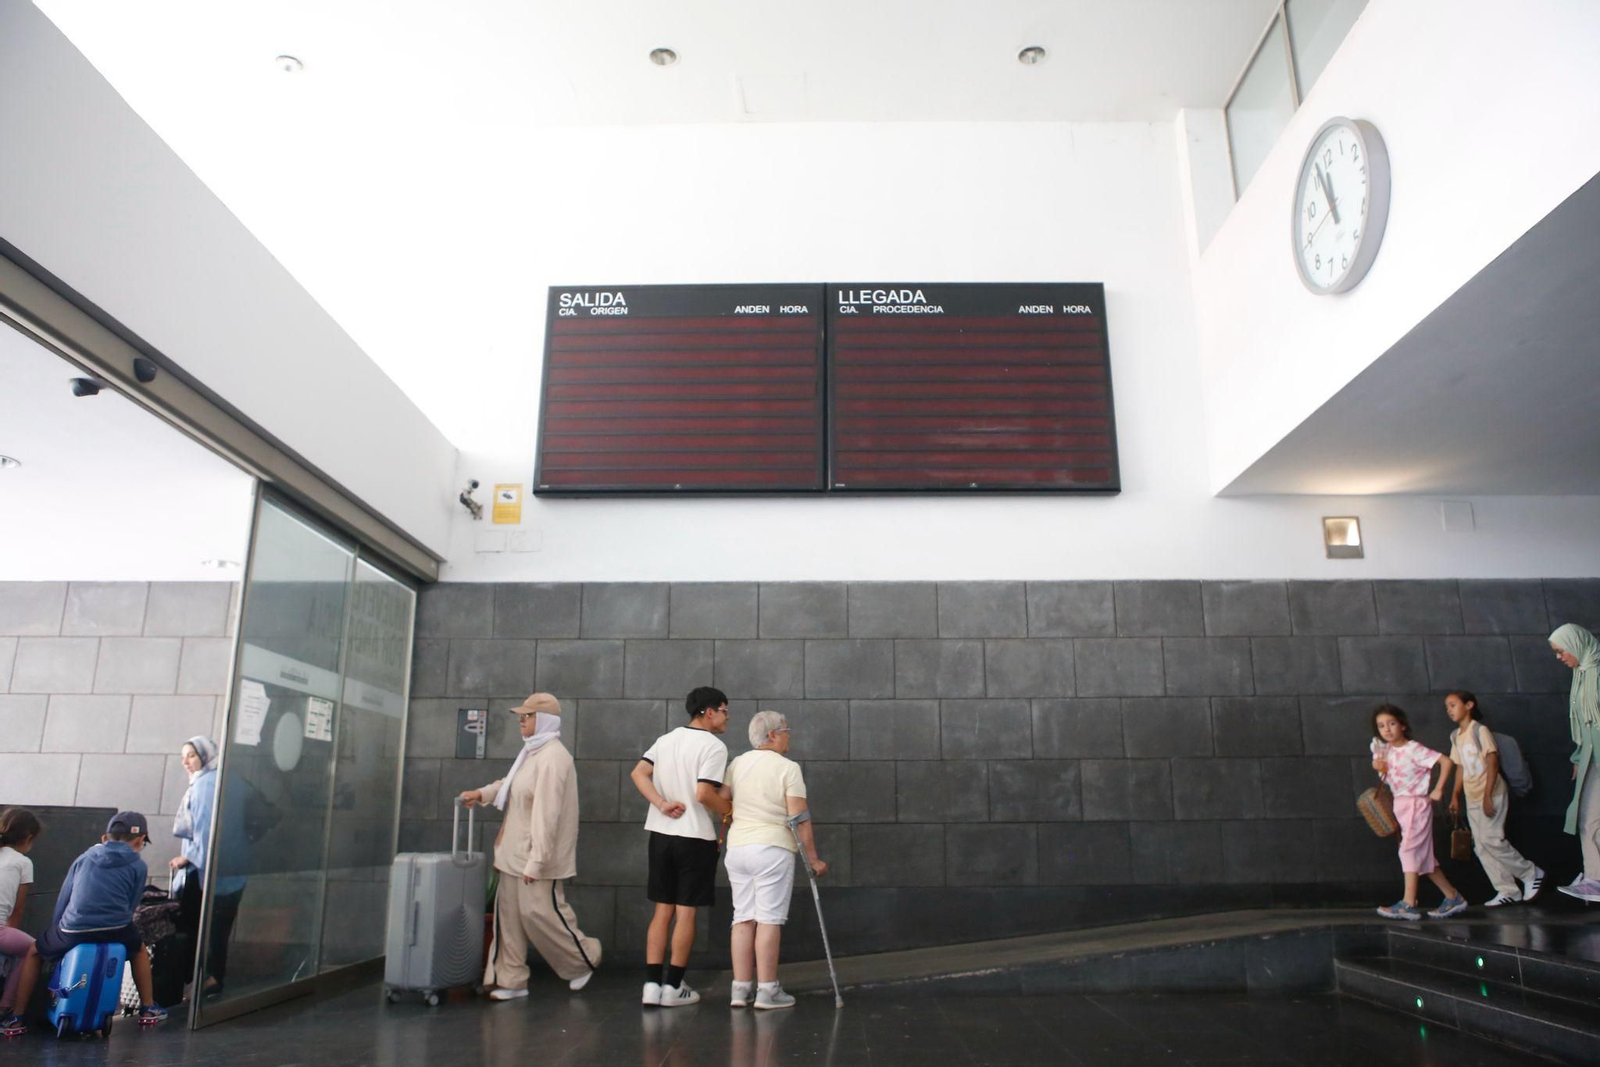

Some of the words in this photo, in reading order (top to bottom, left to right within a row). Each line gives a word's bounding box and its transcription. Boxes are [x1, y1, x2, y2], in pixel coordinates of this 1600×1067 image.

[1339, 139, 1344, 156] 1
[1351, 143, 1359, 163] 2
[1323, 148, 1333, 169] 12
[1307, 201, 1316, 222] 10
[1315, 254, 1321, 270] 8
[1328, 257, 1334, 277] 7
[1341, 254, 1348, 271] 6
[559, 292, 627, 307] SALIDA
[838, 289, 927, 304] LLEGADA
[558, 307, 577, 317] CIA.
[590, 306, 628, 316] ORIGEN
[733, 305, 770, 314] ANDEN
[779, 305, 809, 314] HORA
[839, 305, 859, 314] CIA.
[872, 305, 945, 314] PROCEDENCIA
[1018, 305, 1054, 314] ANDEN
[1062, 305, 1092, 314] HORA
